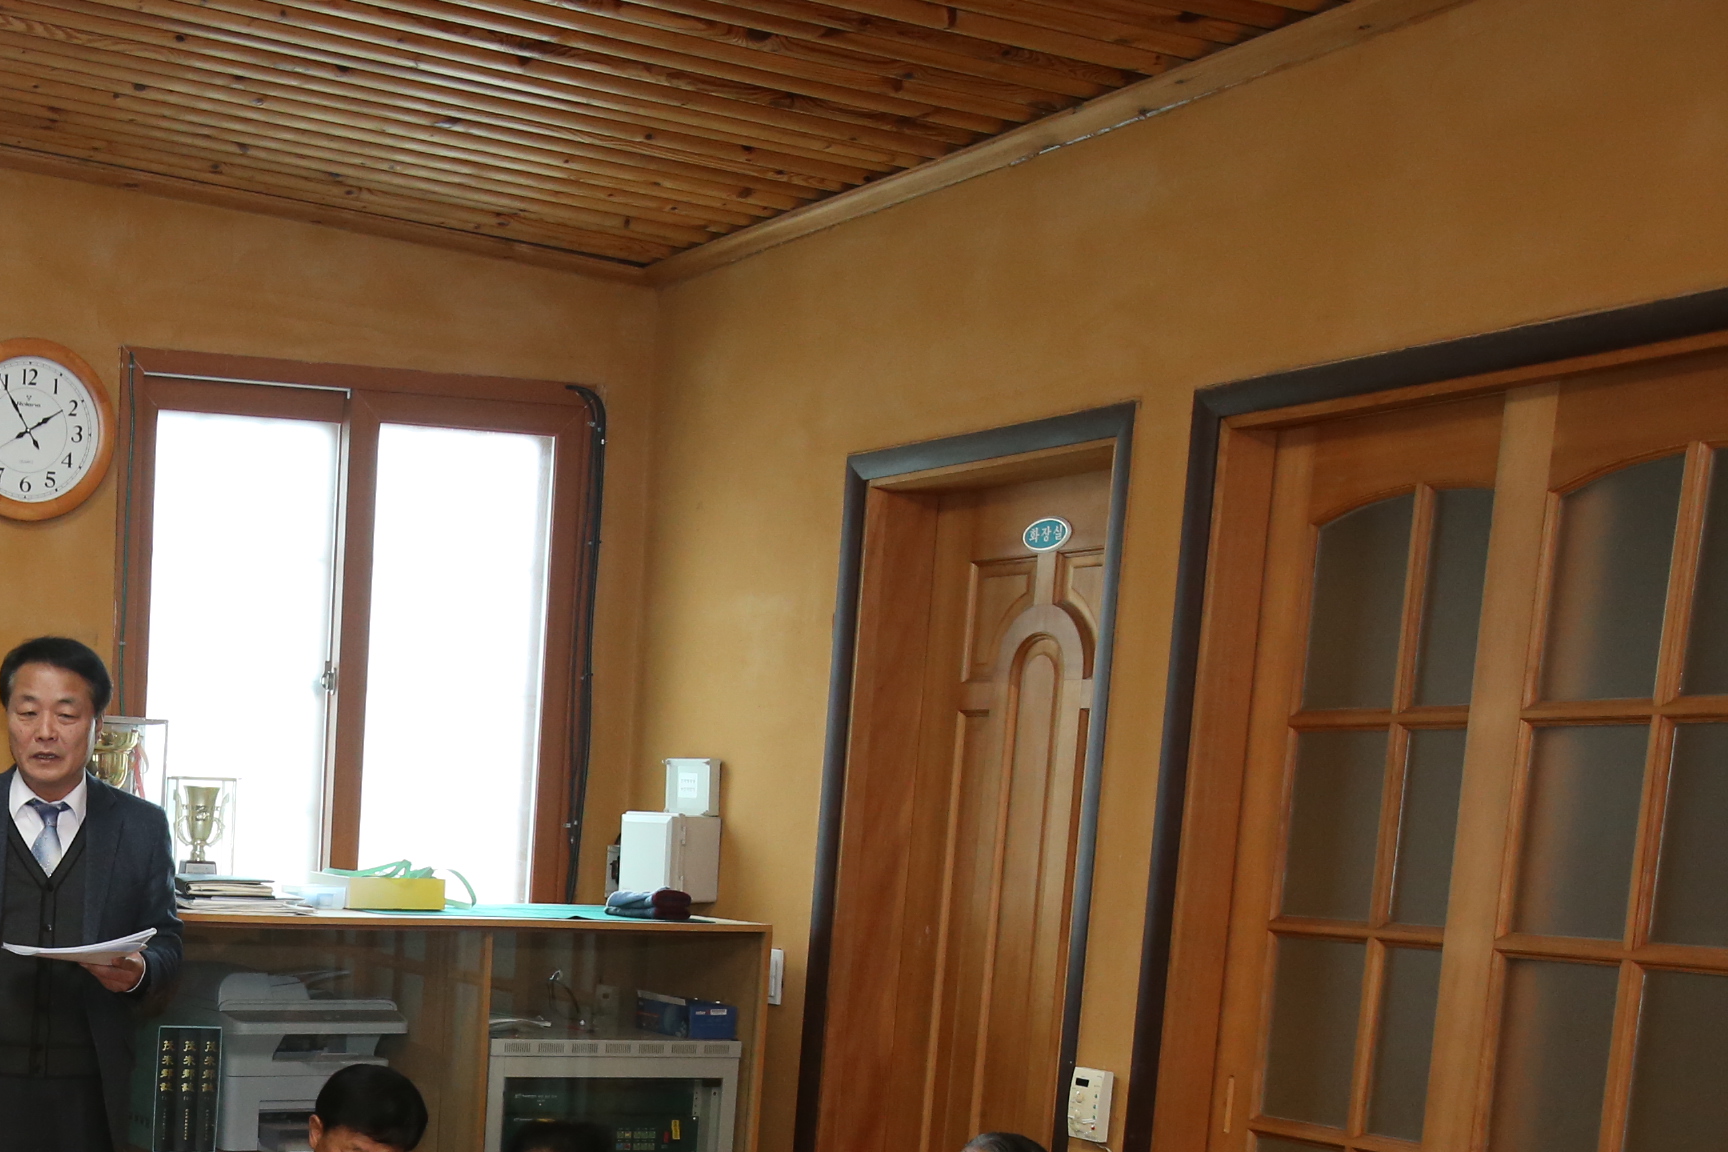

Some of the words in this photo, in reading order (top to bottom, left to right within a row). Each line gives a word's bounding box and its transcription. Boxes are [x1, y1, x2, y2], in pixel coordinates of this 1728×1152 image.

[22, 369, 38, 386] 12
[54, 378, 58, 394] 1
[68, 400, 78, 416] 2
[71, 425, 83, 443] 3
[61, 452, 72, 468] 4
[19, 476, 31, 492] 6
[44, 471, 56, 488] 5
[1029, 524, 1063, 543] 화장실
